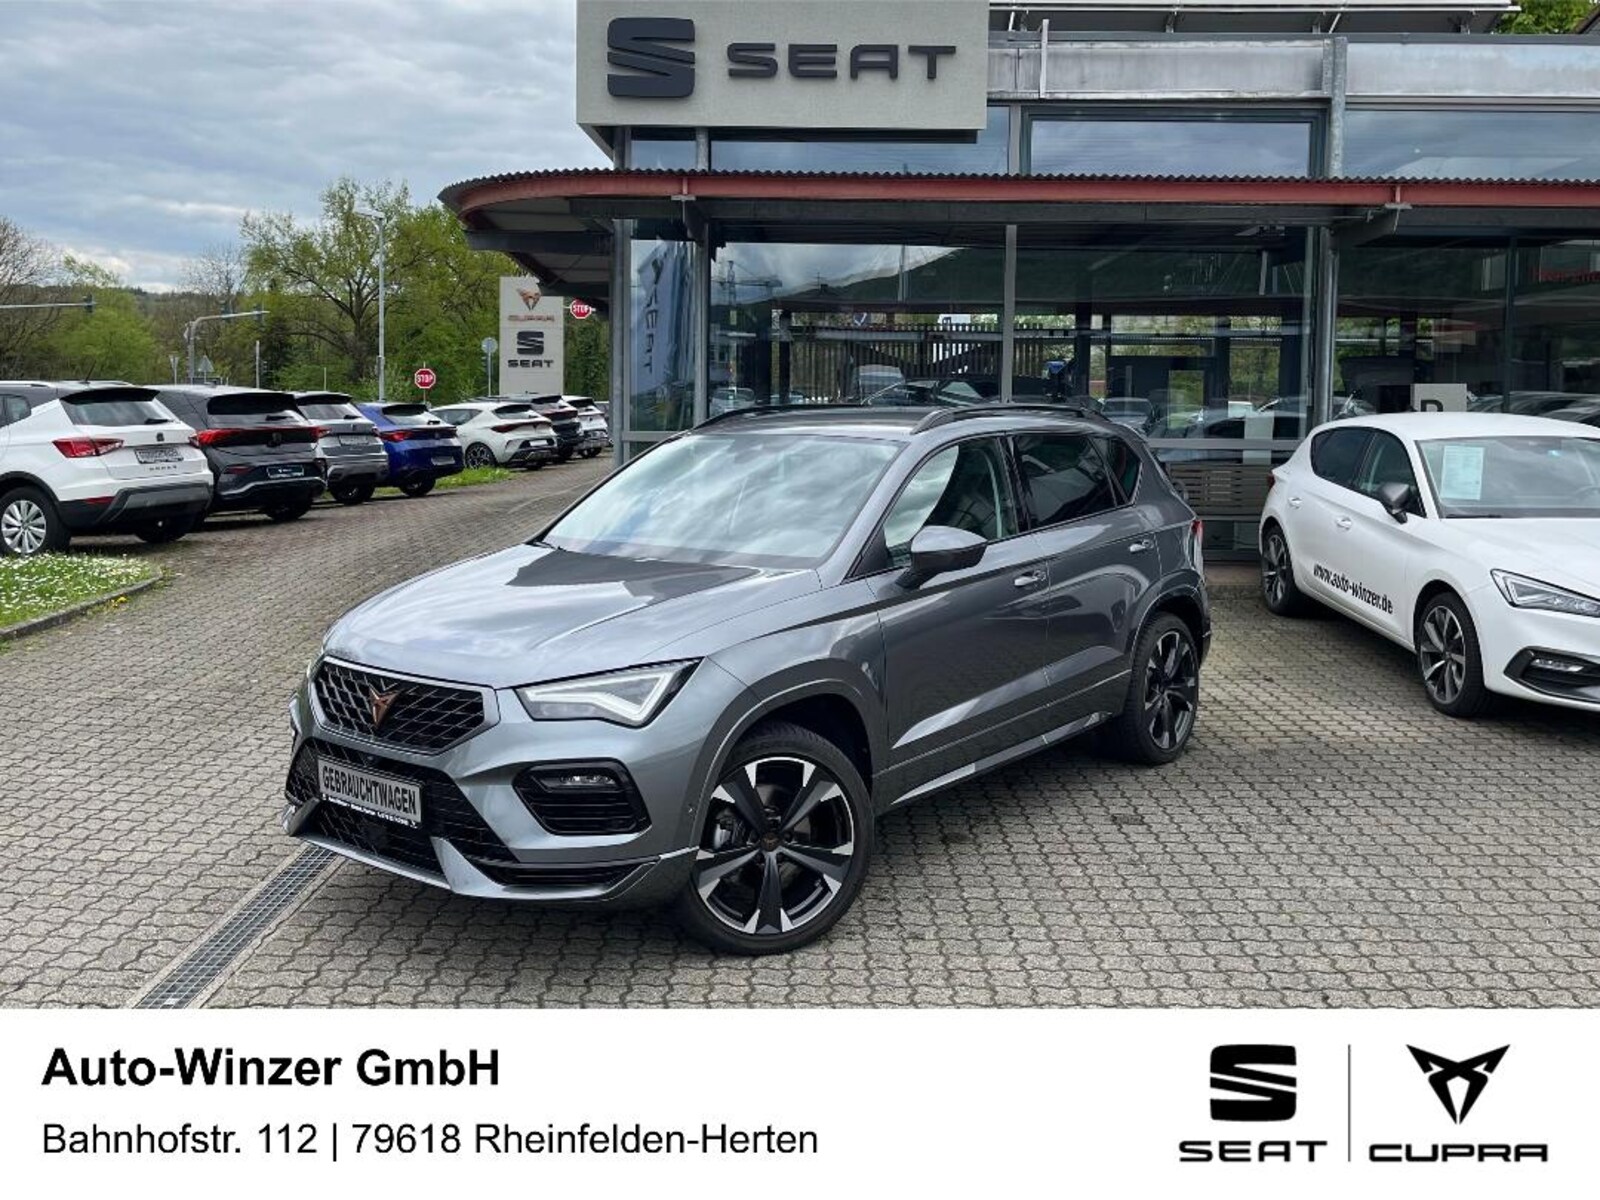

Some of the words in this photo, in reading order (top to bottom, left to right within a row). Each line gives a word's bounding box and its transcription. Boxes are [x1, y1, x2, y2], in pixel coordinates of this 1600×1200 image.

[727, 42, 957, 80] SEAT
[416, 374, 434, 383] STOP
[507, 359, 554, 368] SEAT
[1313, 562, 1394, 615] www.auto-winzer.de
[321, 765, 417, 816] GEBRAUCHTWAGEN
